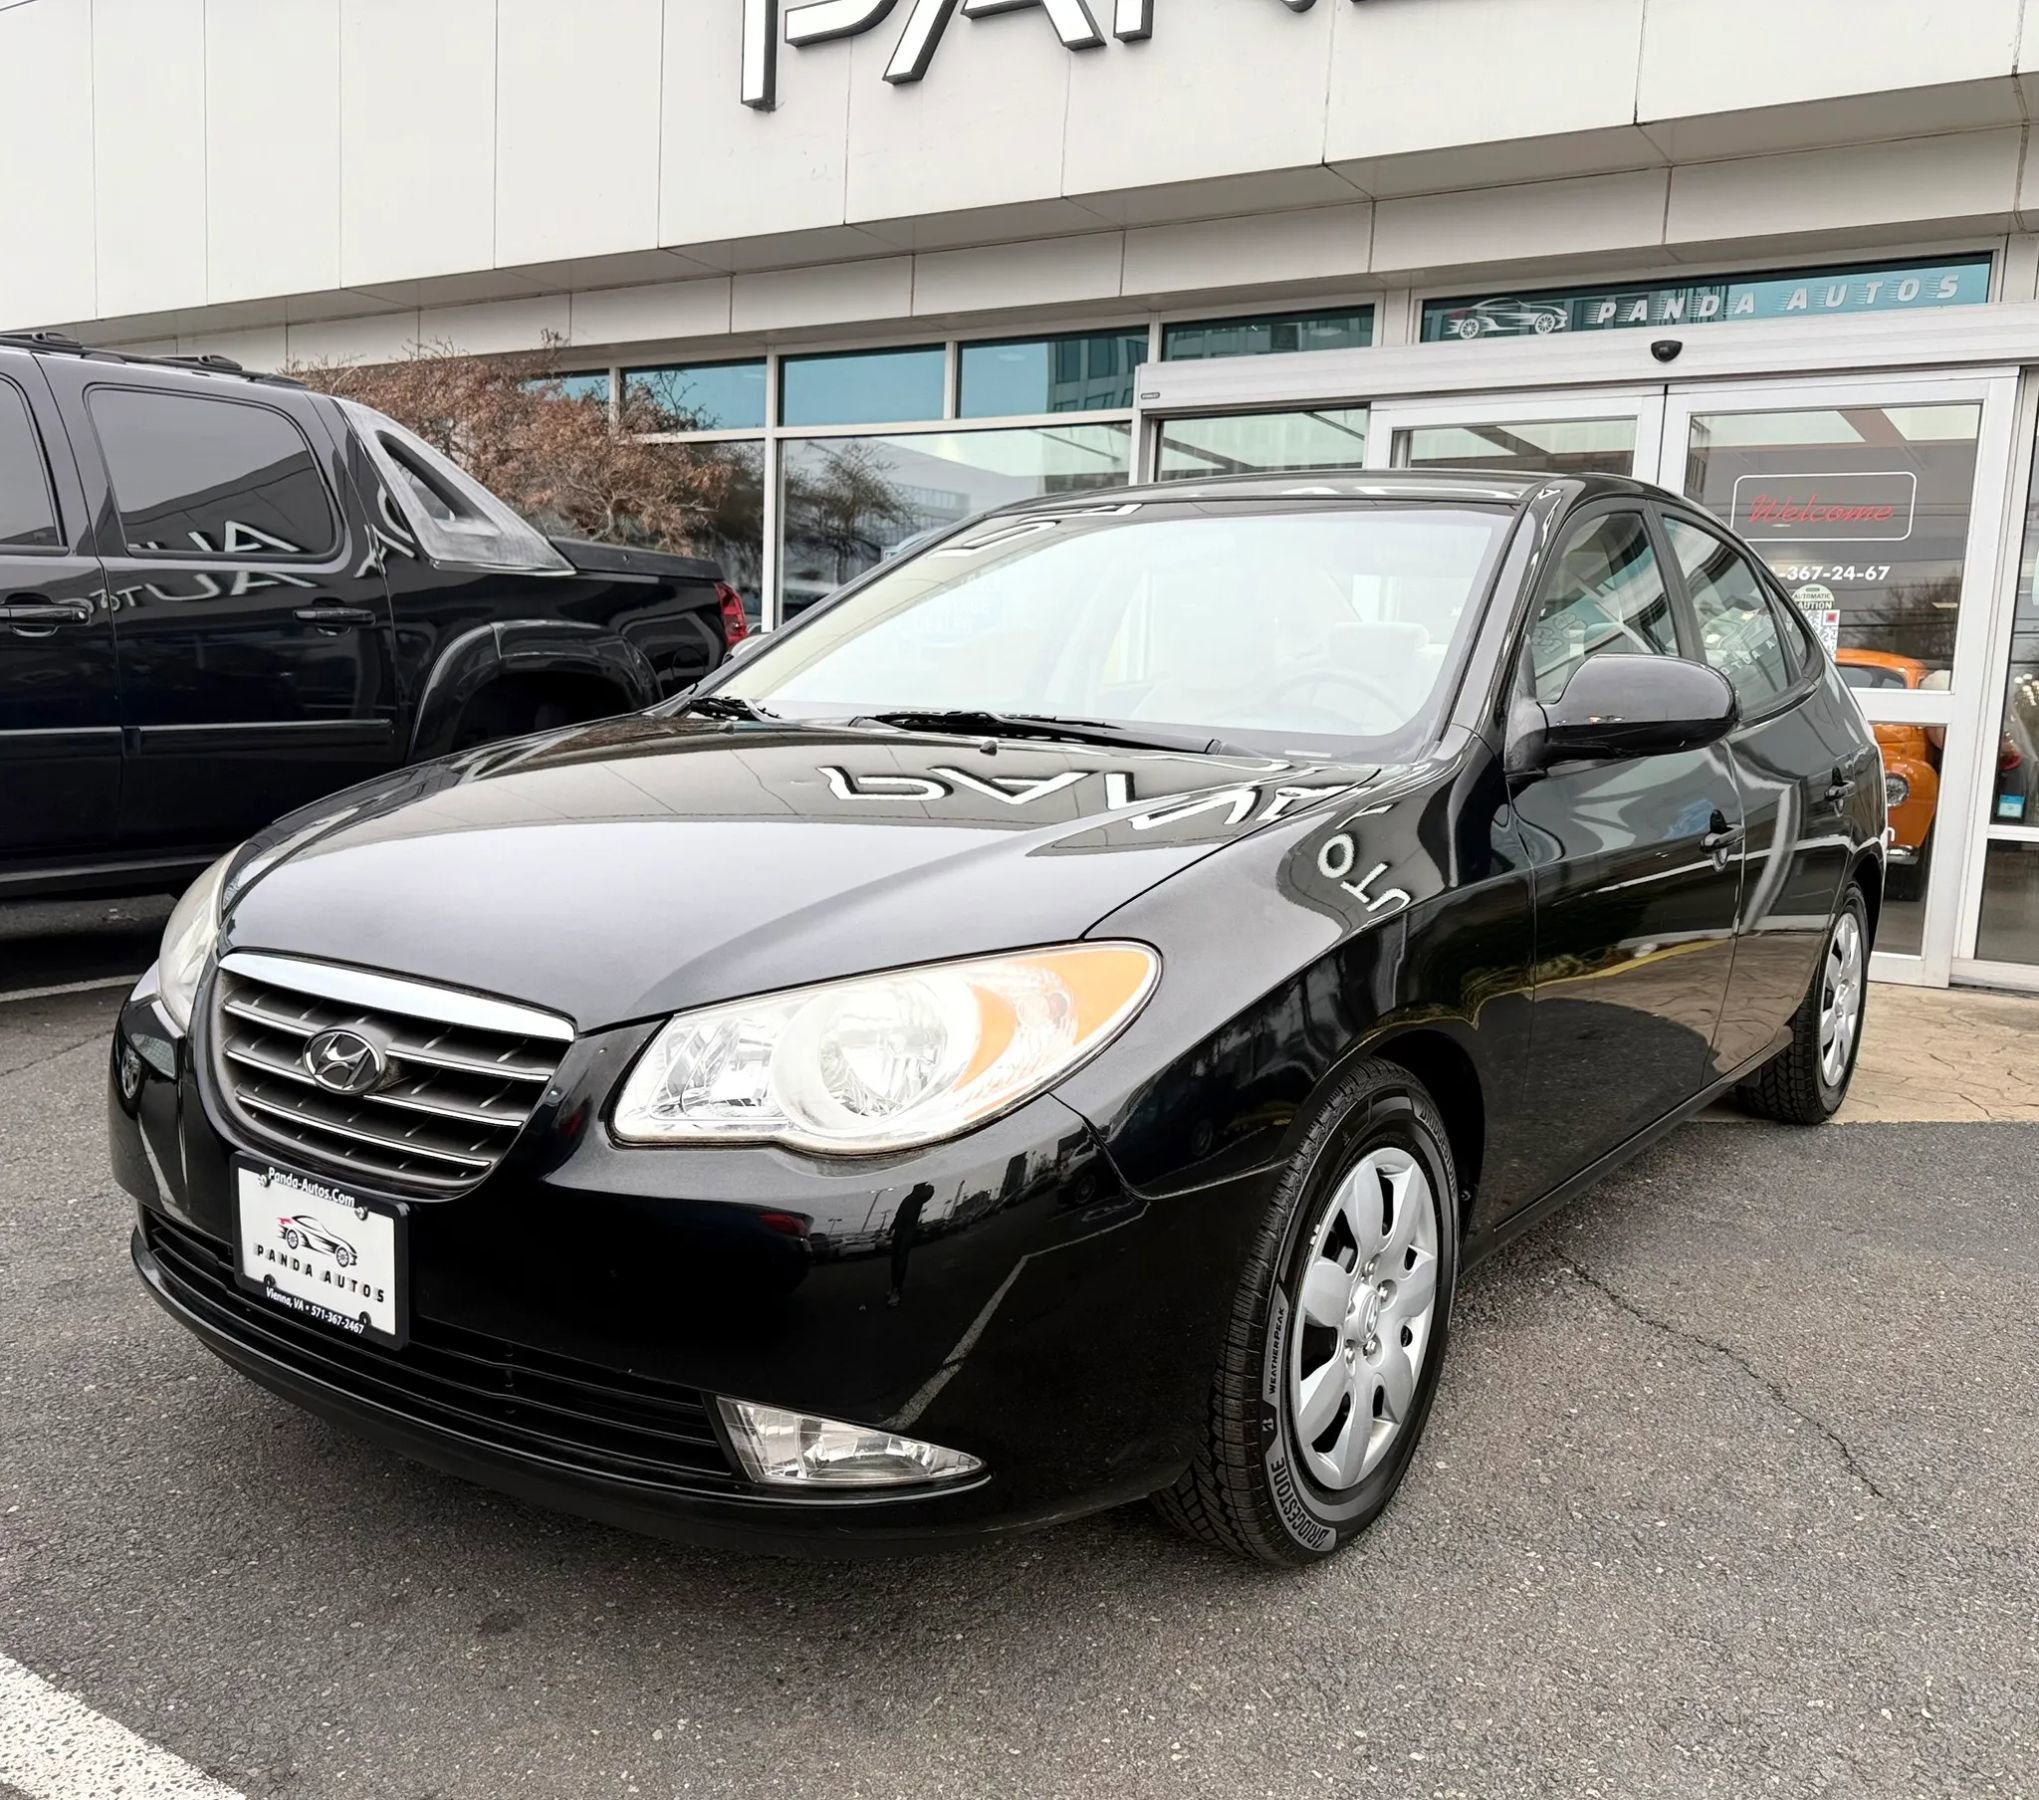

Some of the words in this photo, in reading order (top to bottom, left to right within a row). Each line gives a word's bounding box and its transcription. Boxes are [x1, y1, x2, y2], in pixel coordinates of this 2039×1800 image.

[1594, 293, 1755, 324] PANDA
[1782, 275, 1960, 311] AUTOS
[1749, 491, 1894, 523] Welcome
[1793, 592, 1832, 600] AUTOMATIC
[1797, 601, 1833, 610] AUTION
[268, 1166, 355, 1209] Panda-Autos.Com
[255, 1244, 313, 1278] PANDA
[322, 1270, 385, 1303] AUTOS
[293, 1297, 305, 1312] VA
[311, 1304, 365, 1335] 571-367-2467
[1270, 1456, 1331, 1550] BRIDGESTONE
